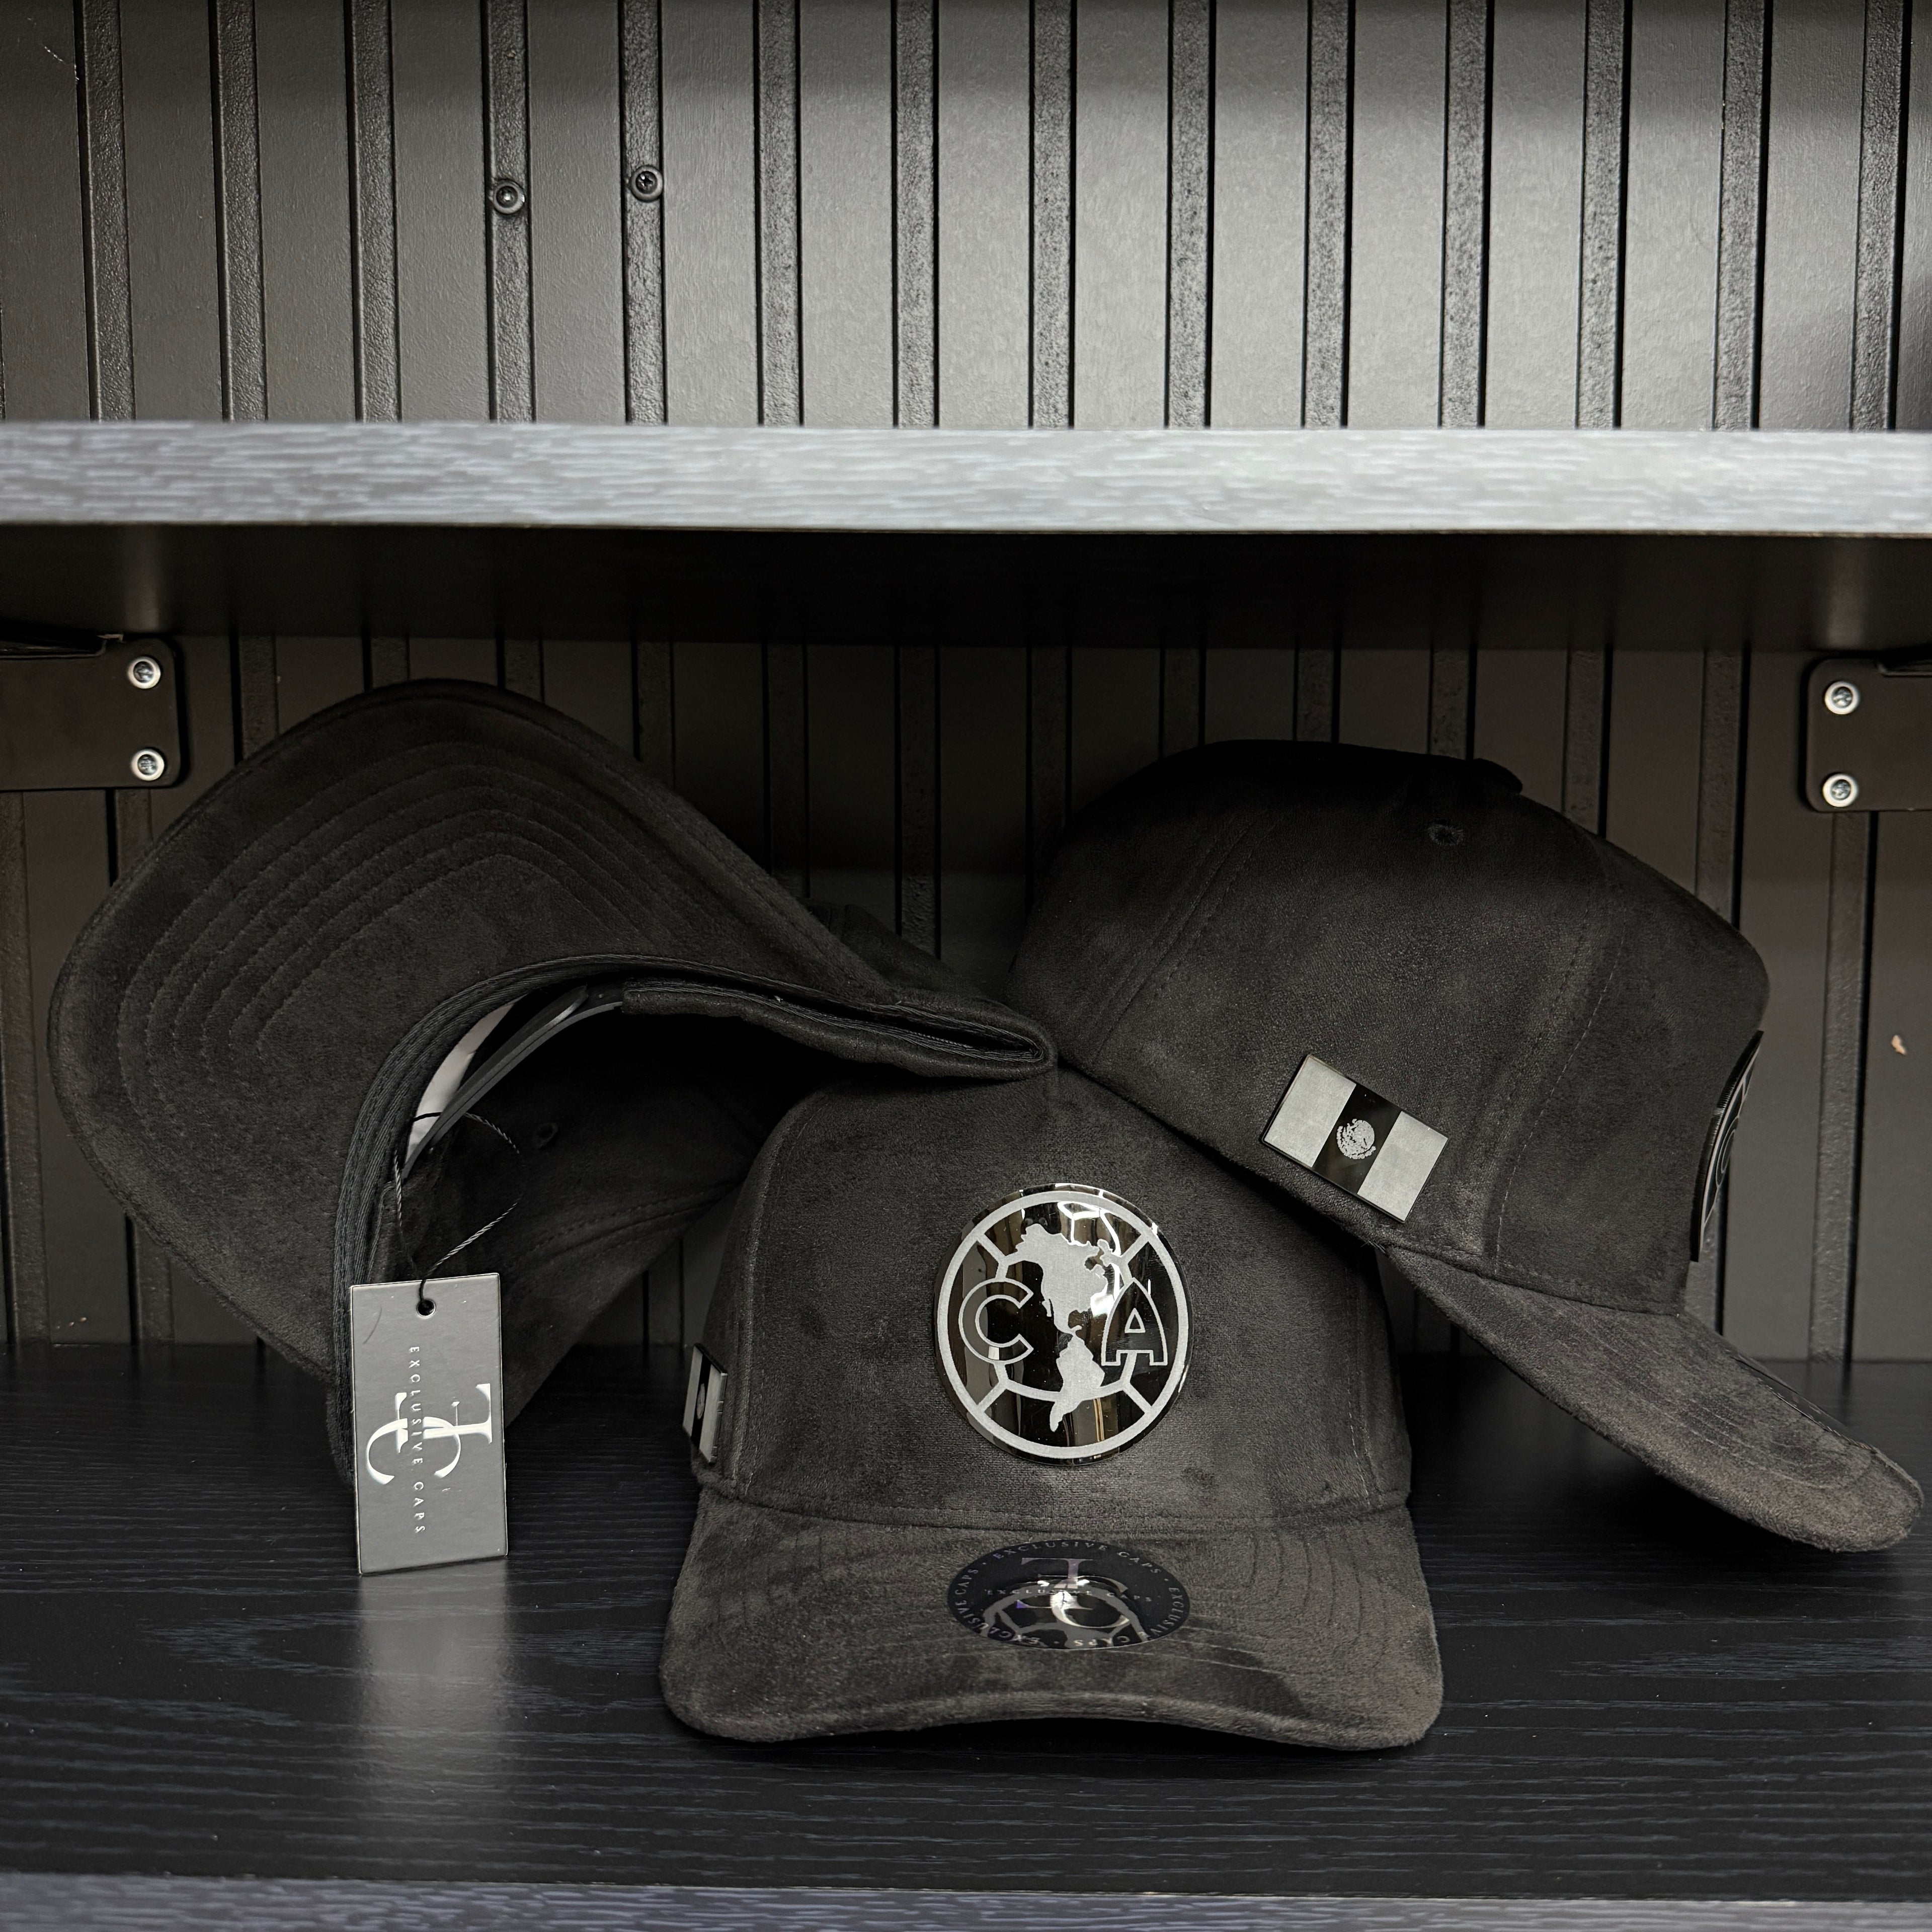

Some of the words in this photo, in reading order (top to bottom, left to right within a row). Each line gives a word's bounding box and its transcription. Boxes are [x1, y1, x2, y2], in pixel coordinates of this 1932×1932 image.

[958, 1277, 1034, 1364] C
[1101, 1277, 1168, 1366] A
[408, 1345, 423, 1465] EXCLUSIVE
[413, 1480, 426, 1533] CAPS
[954, 1569, 979, 1595] CAPS
[993, 1541, 1108, 1559] EXCLUSIVE
[1117, 1551, 1162, 1573] CAPS
